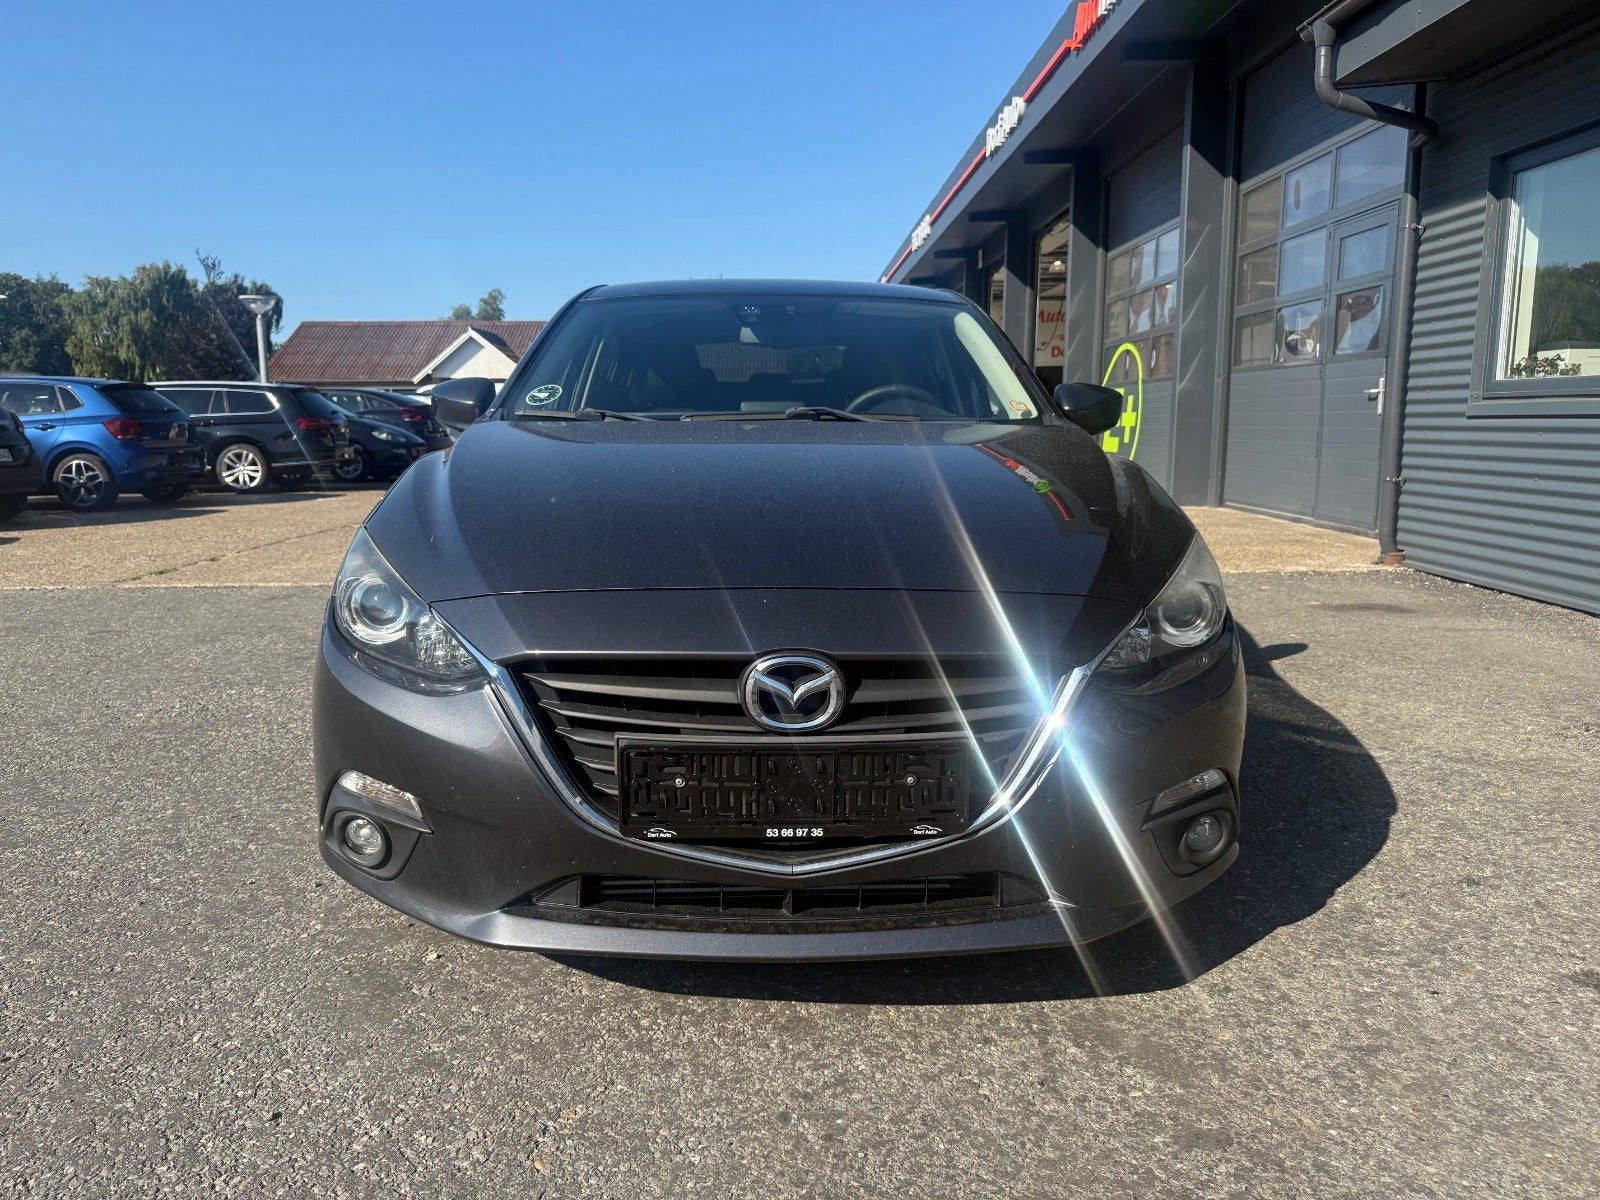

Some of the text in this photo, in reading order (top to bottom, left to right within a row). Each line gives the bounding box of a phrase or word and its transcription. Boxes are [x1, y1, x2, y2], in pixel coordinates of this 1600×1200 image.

[766, 828, 824, 837] 53 66 97 35
